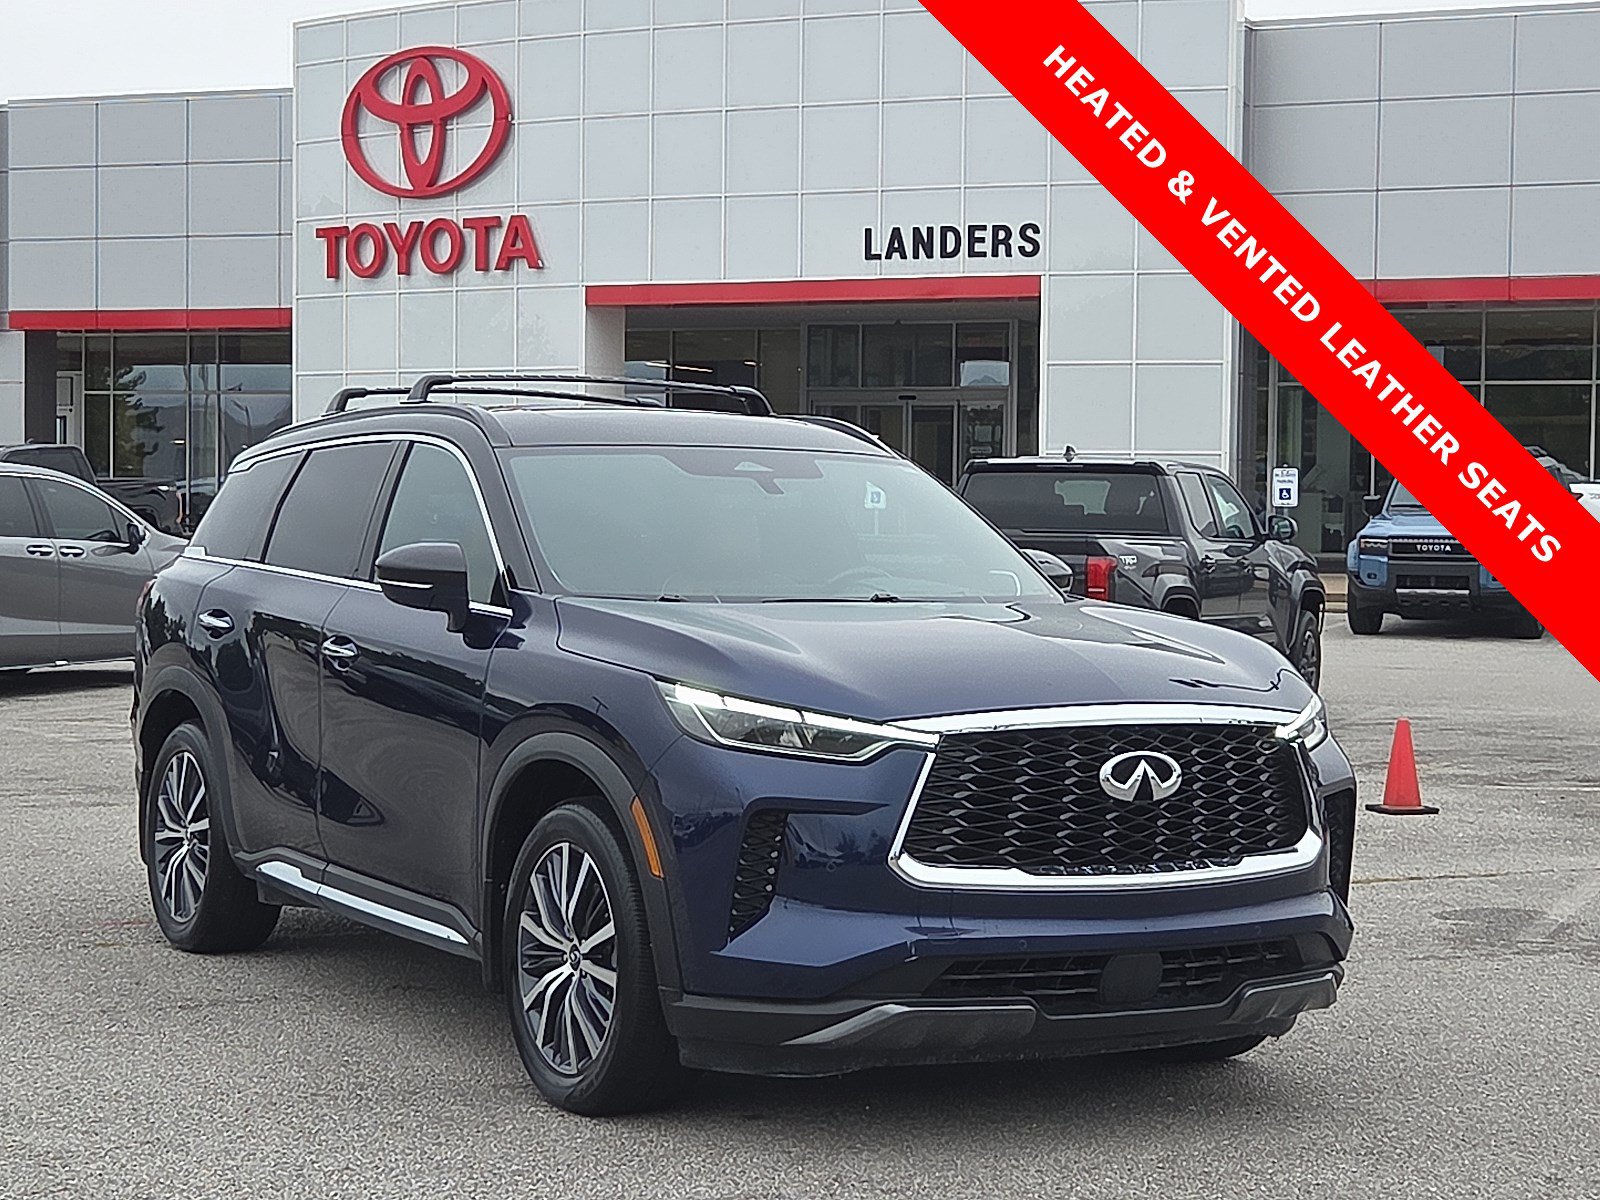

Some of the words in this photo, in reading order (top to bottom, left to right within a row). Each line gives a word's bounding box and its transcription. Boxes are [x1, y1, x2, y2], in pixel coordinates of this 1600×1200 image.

[315, 215, 544, 279] TOYOTA
[864, 223, 1041, 260] LANDERS
[1415, 544, 1452, 552] TOYOTA
